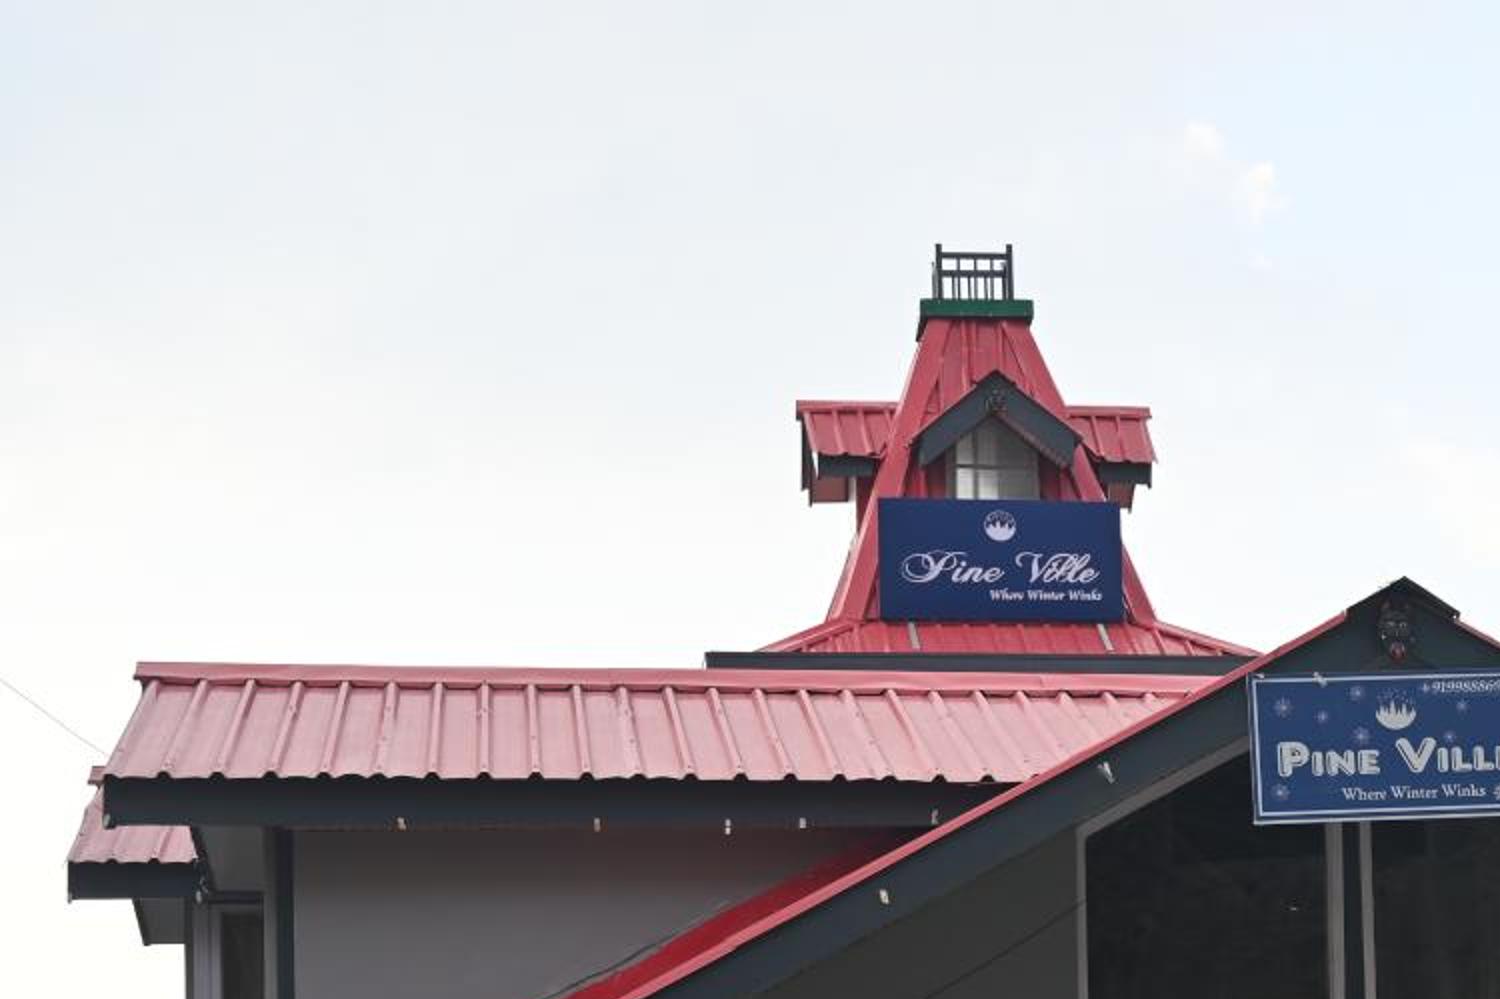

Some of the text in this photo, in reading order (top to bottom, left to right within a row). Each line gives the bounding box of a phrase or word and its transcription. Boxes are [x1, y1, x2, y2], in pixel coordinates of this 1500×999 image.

[902, 549, 1101, 583] Pine Ville
[989, 587, 1103, 601] Where Winter Winks
[1277, 740, 1381, 778] PINE
[1341, 783, 1487, 801] Where Winter Winks
